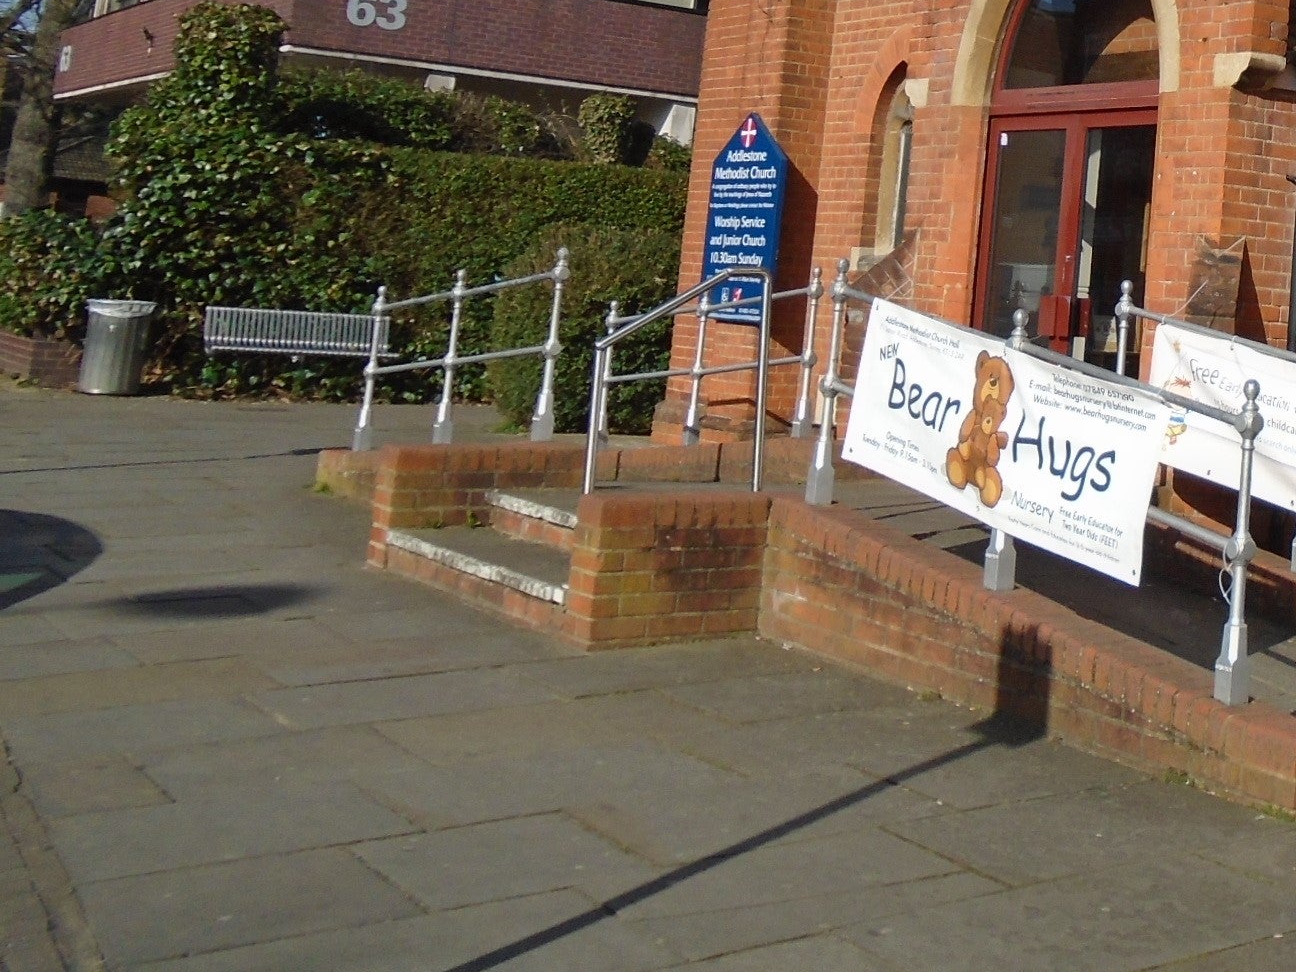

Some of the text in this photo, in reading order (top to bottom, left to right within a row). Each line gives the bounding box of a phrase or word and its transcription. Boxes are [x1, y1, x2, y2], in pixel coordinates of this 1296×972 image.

[726, 149, 768, 163] Addlestone
[714, 165, 777, 180] Methodist Church
[714, 215, 766, 230] Worship Service
[709, 233, 766, 248] and Junior Church
[710, 251, 764, 267] 10.30am Sunday
[879, 342, 900, 362] NEW
[1189, 358, 1220, 385] Free
[887, 357, 962, 433] Bear
[886, 431, 907, 449] Opening
[884, 442, 899, 458] Friday
[1011, 411, 1117, 502] Hugs
[1010, 490, 1055, 524] Nursery
[1061, 519, 1072, 532] Two
[1072, 523, 1087, 536] Year
[1072, 511, 1088, 525] Early
[1087, 516, 1114, 535] Education
